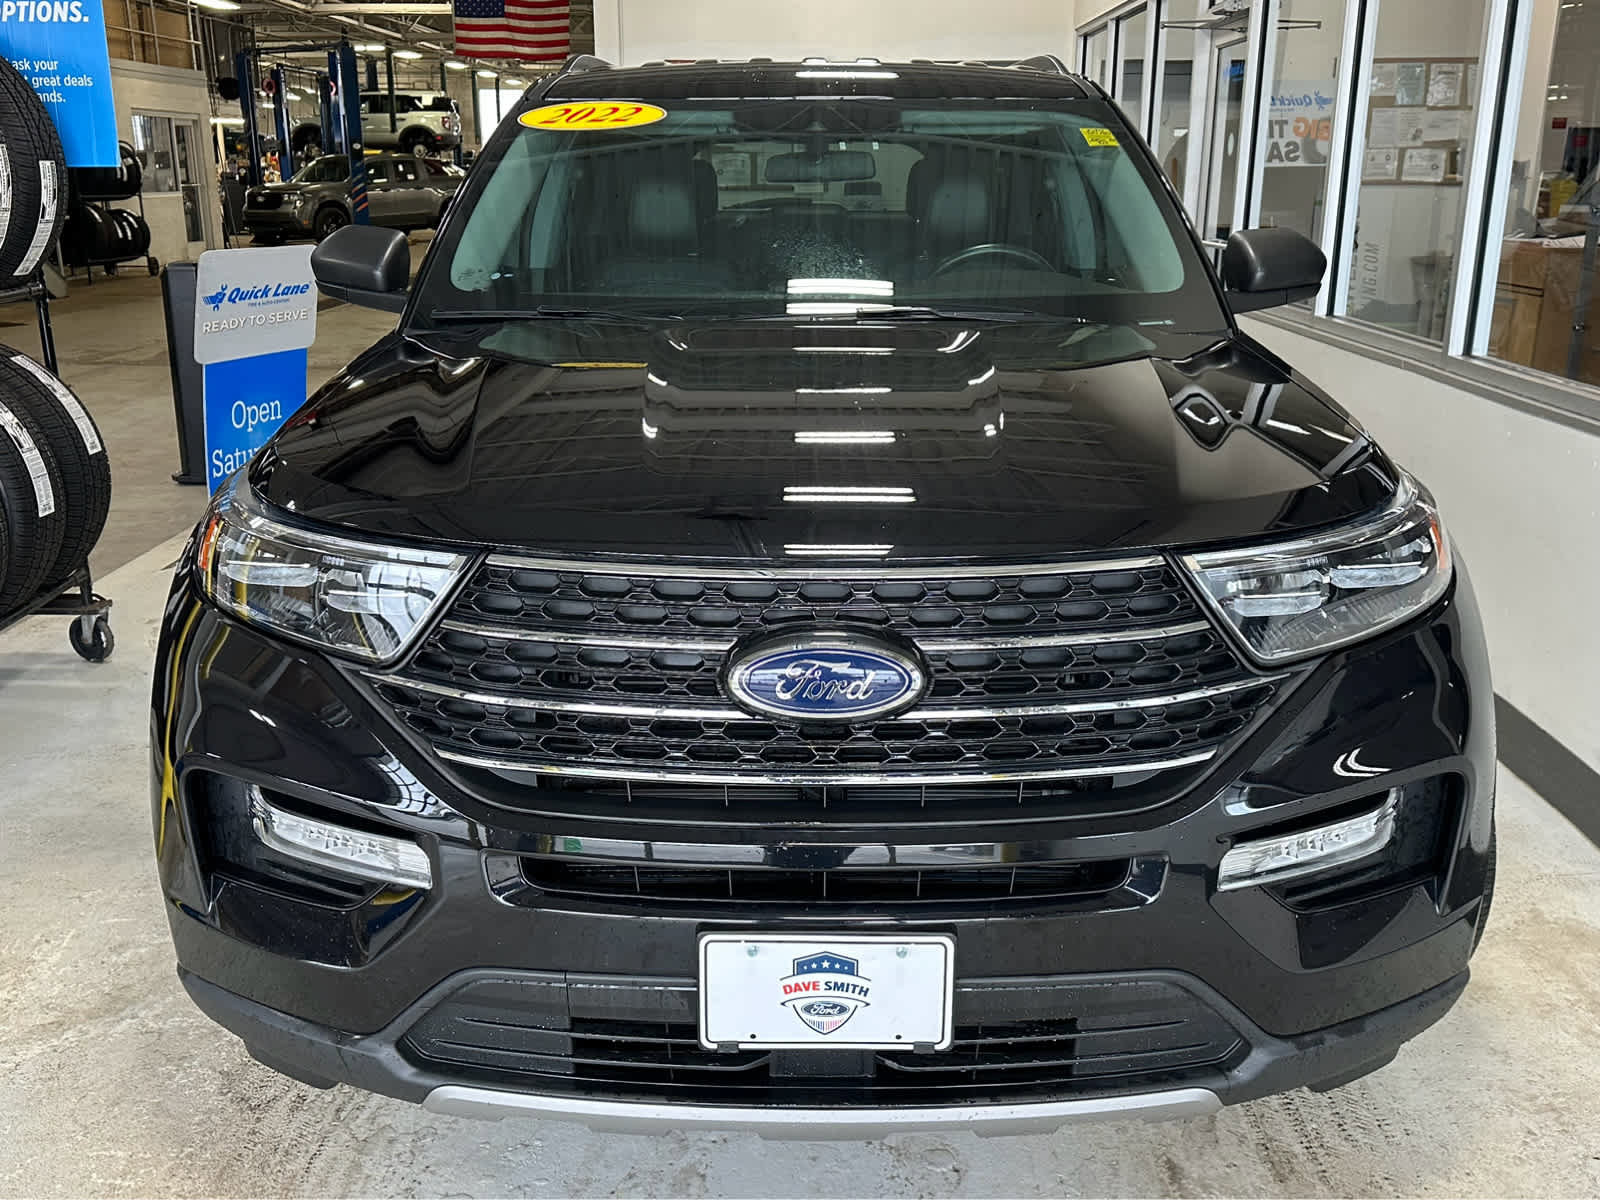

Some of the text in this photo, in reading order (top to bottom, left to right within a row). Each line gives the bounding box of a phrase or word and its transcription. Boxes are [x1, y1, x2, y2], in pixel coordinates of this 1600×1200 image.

[0, 0, 89, 22] PTIONS.
[12, 58, 58, 73] ask your
[32, 75, 61, 89] great
[64, 74, 94, 87] deals
[538, 107, 643, 125] 2022
[227, 284, 272, 304] Quick
[273, 283, 310, 297] Lane
[202, 308, 308, 334] READY TO SERVE
[231, 400, 283, 433] Open
[775, 659, 876, 701] Ford
[782, 981, 870, 997] DAVE SMITH
[810, 1003, 841, 1015] Ford
